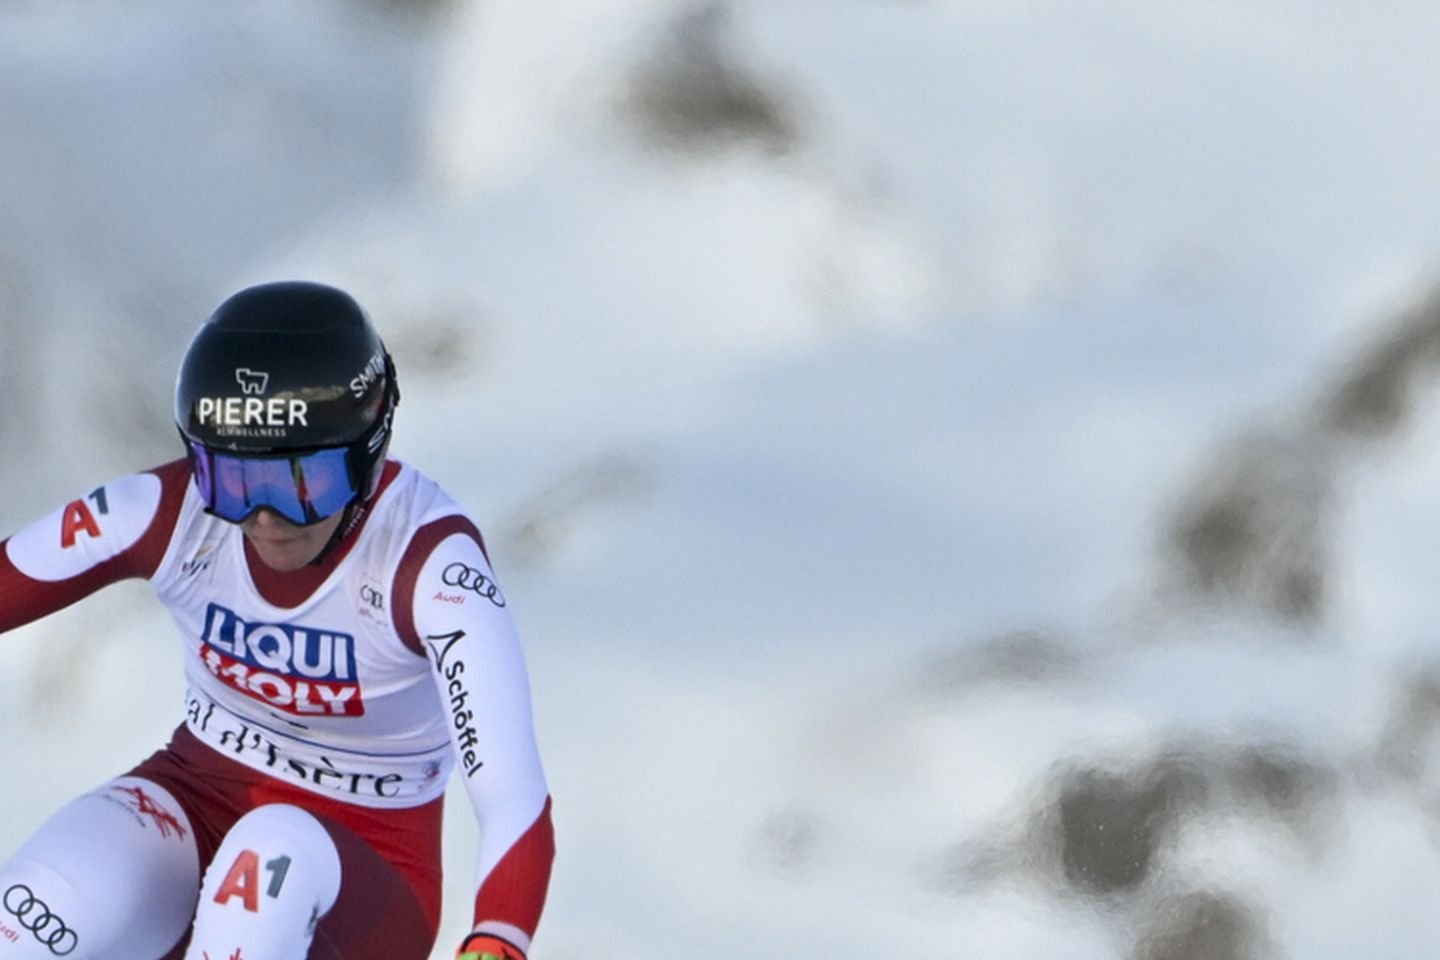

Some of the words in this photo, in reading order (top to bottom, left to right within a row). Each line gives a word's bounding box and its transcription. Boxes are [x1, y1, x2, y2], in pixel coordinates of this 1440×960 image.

[198, 397, 308, 427] PIERER
[60, 486, 109, 548] A1
[432, 591, 466, 605] Audi
[209, 608, 349, 680] LIQUI
[205, 649, 357, 714] MOLY
[445, 660, 483, 778] Schöffel
[213, 849, 292, 913] A1
